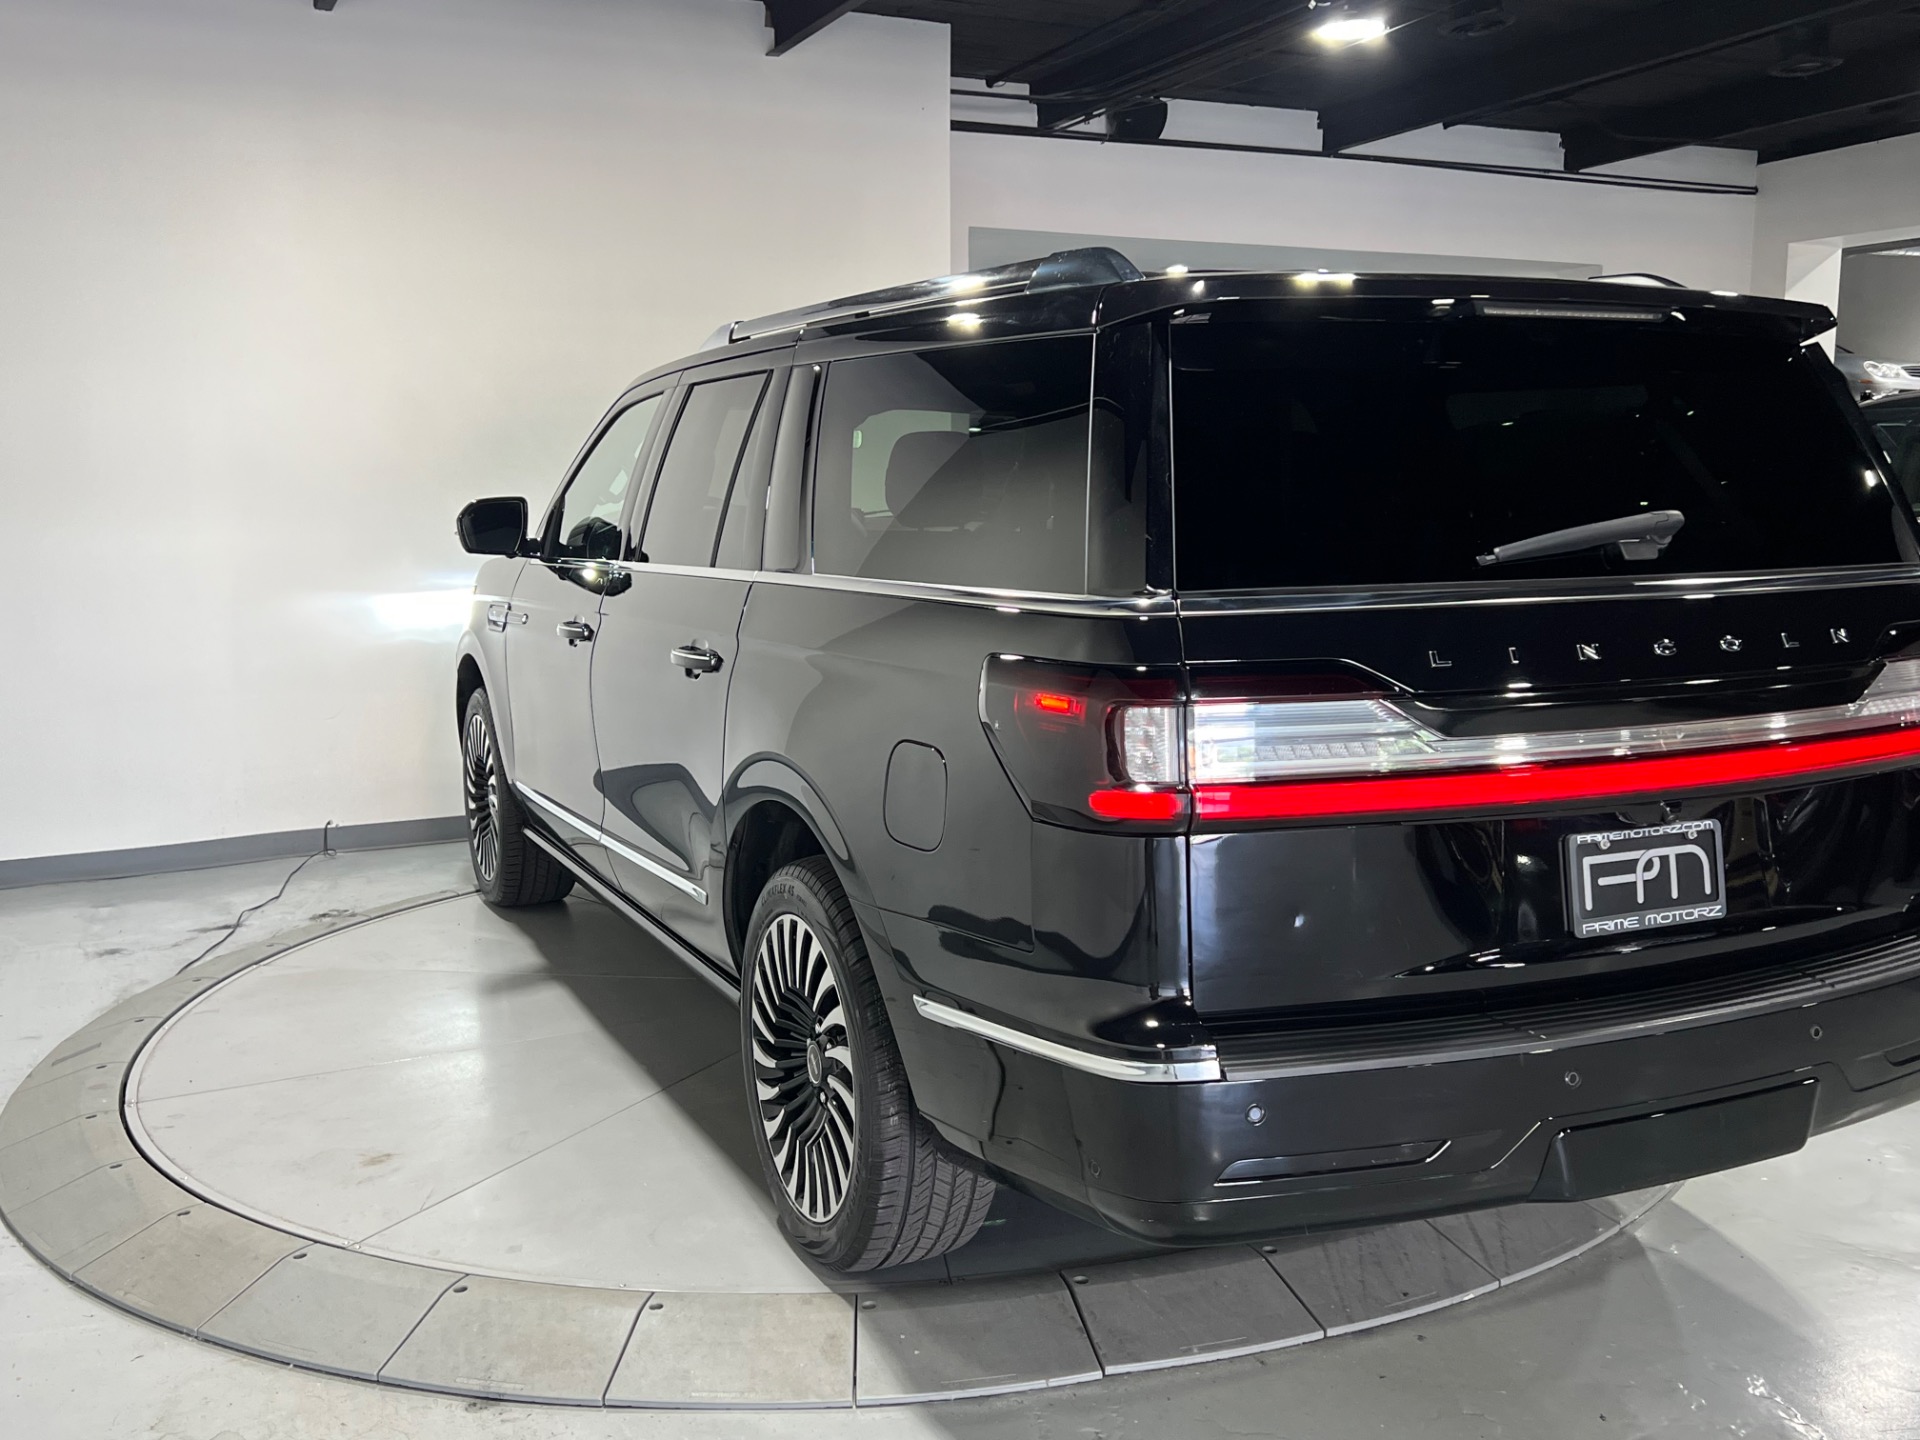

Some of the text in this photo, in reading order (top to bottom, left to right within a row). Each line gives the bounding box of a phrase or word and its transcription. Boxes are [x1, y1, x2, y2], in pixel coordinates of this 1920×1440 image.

[1429, 626, 1851, 668] LINCOLN
[1582, 905, 1723, 935] PRIME MOTORZ
